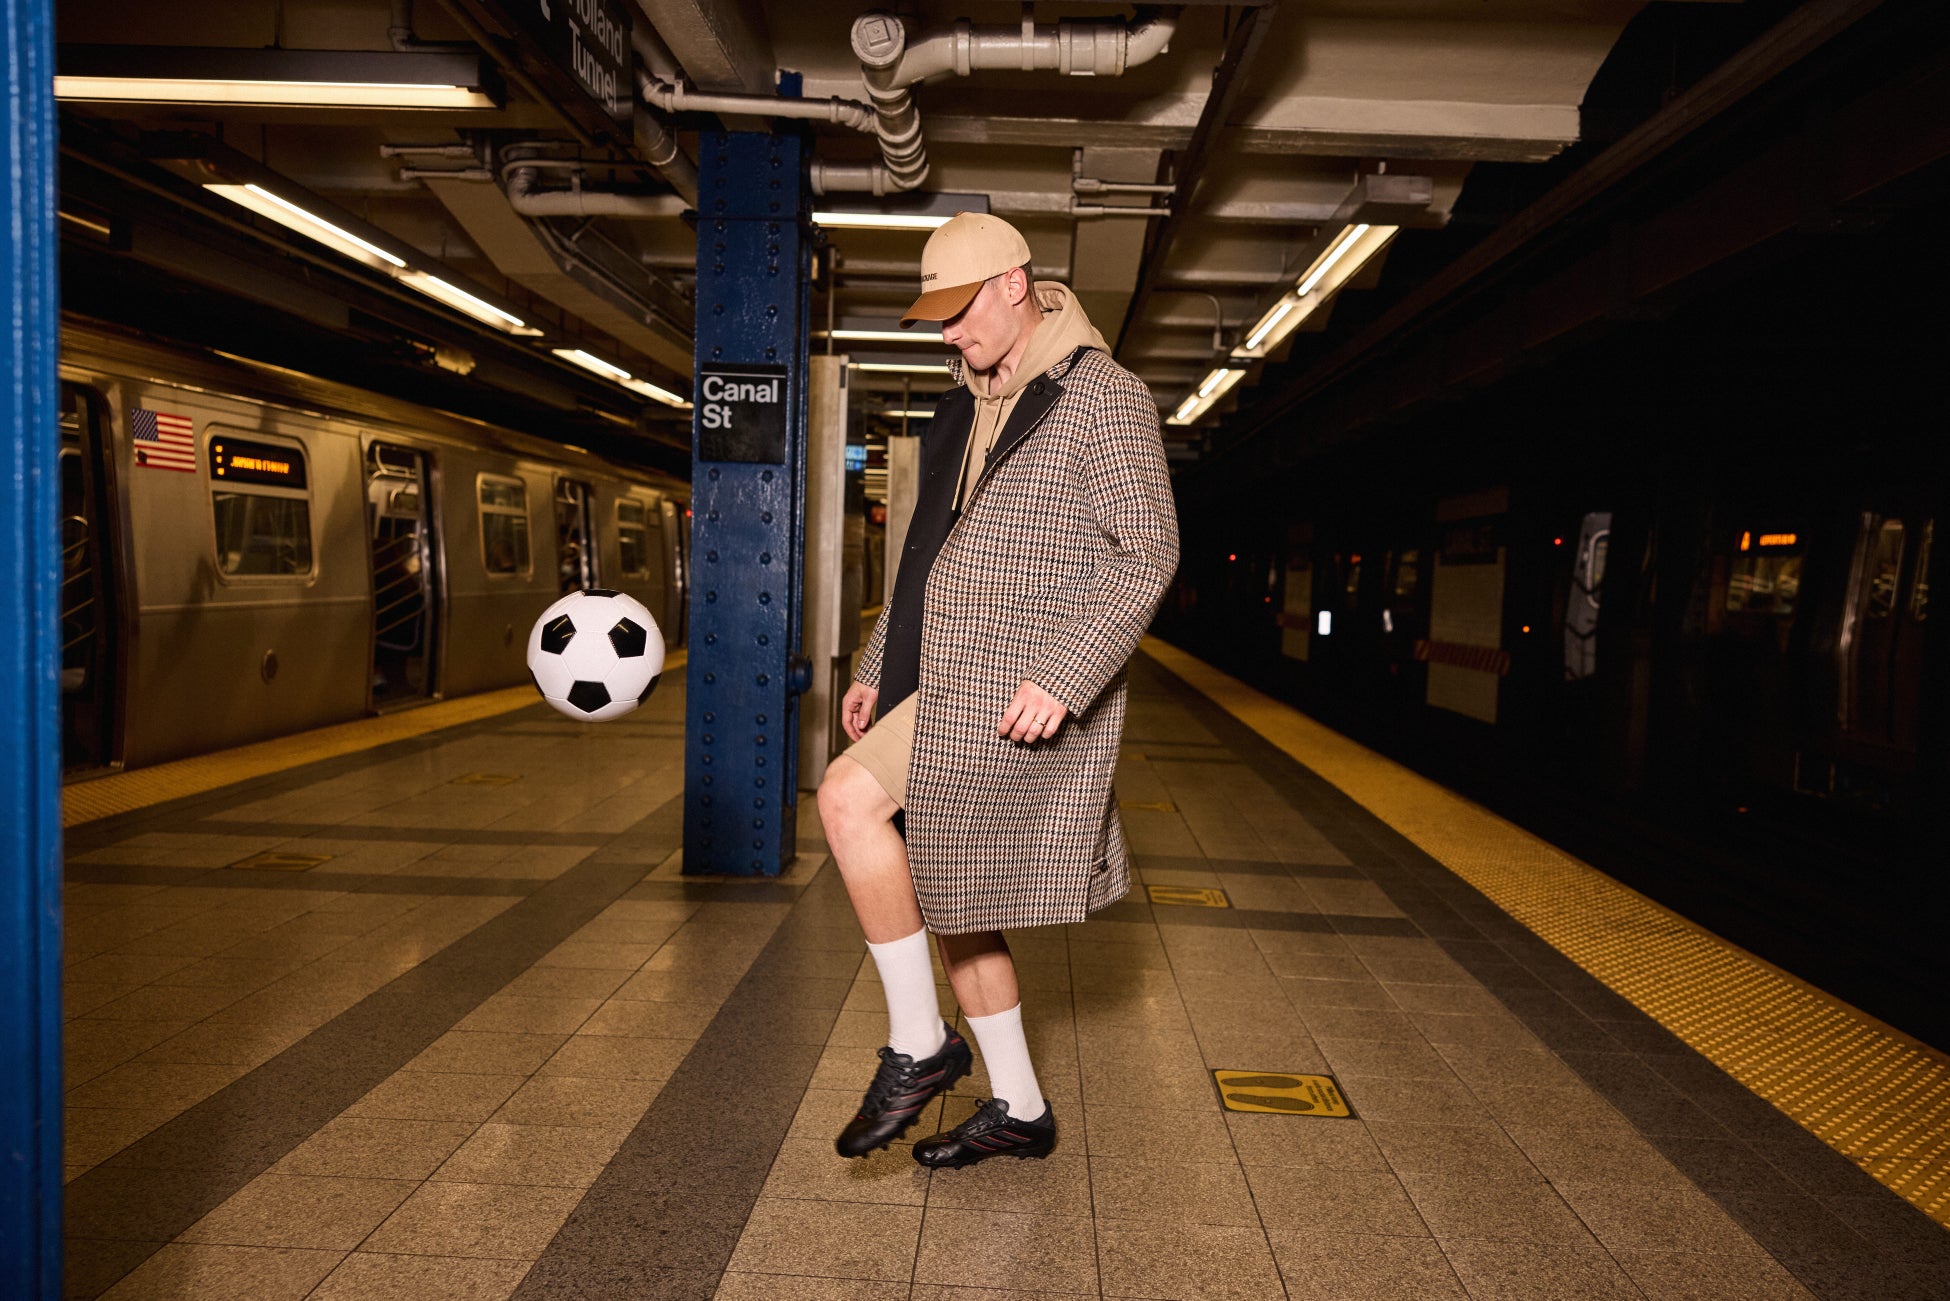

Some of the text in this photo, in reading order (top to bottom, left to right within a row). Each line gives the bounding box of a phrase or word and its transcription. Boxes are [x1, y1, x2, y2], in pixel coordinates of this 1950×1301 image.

[568, 0, 623, 67] olland
[568, 17, 618, 113] Tunnel
[702, 376, 779, 403] Canal
[701, 403, 732, 429] St
